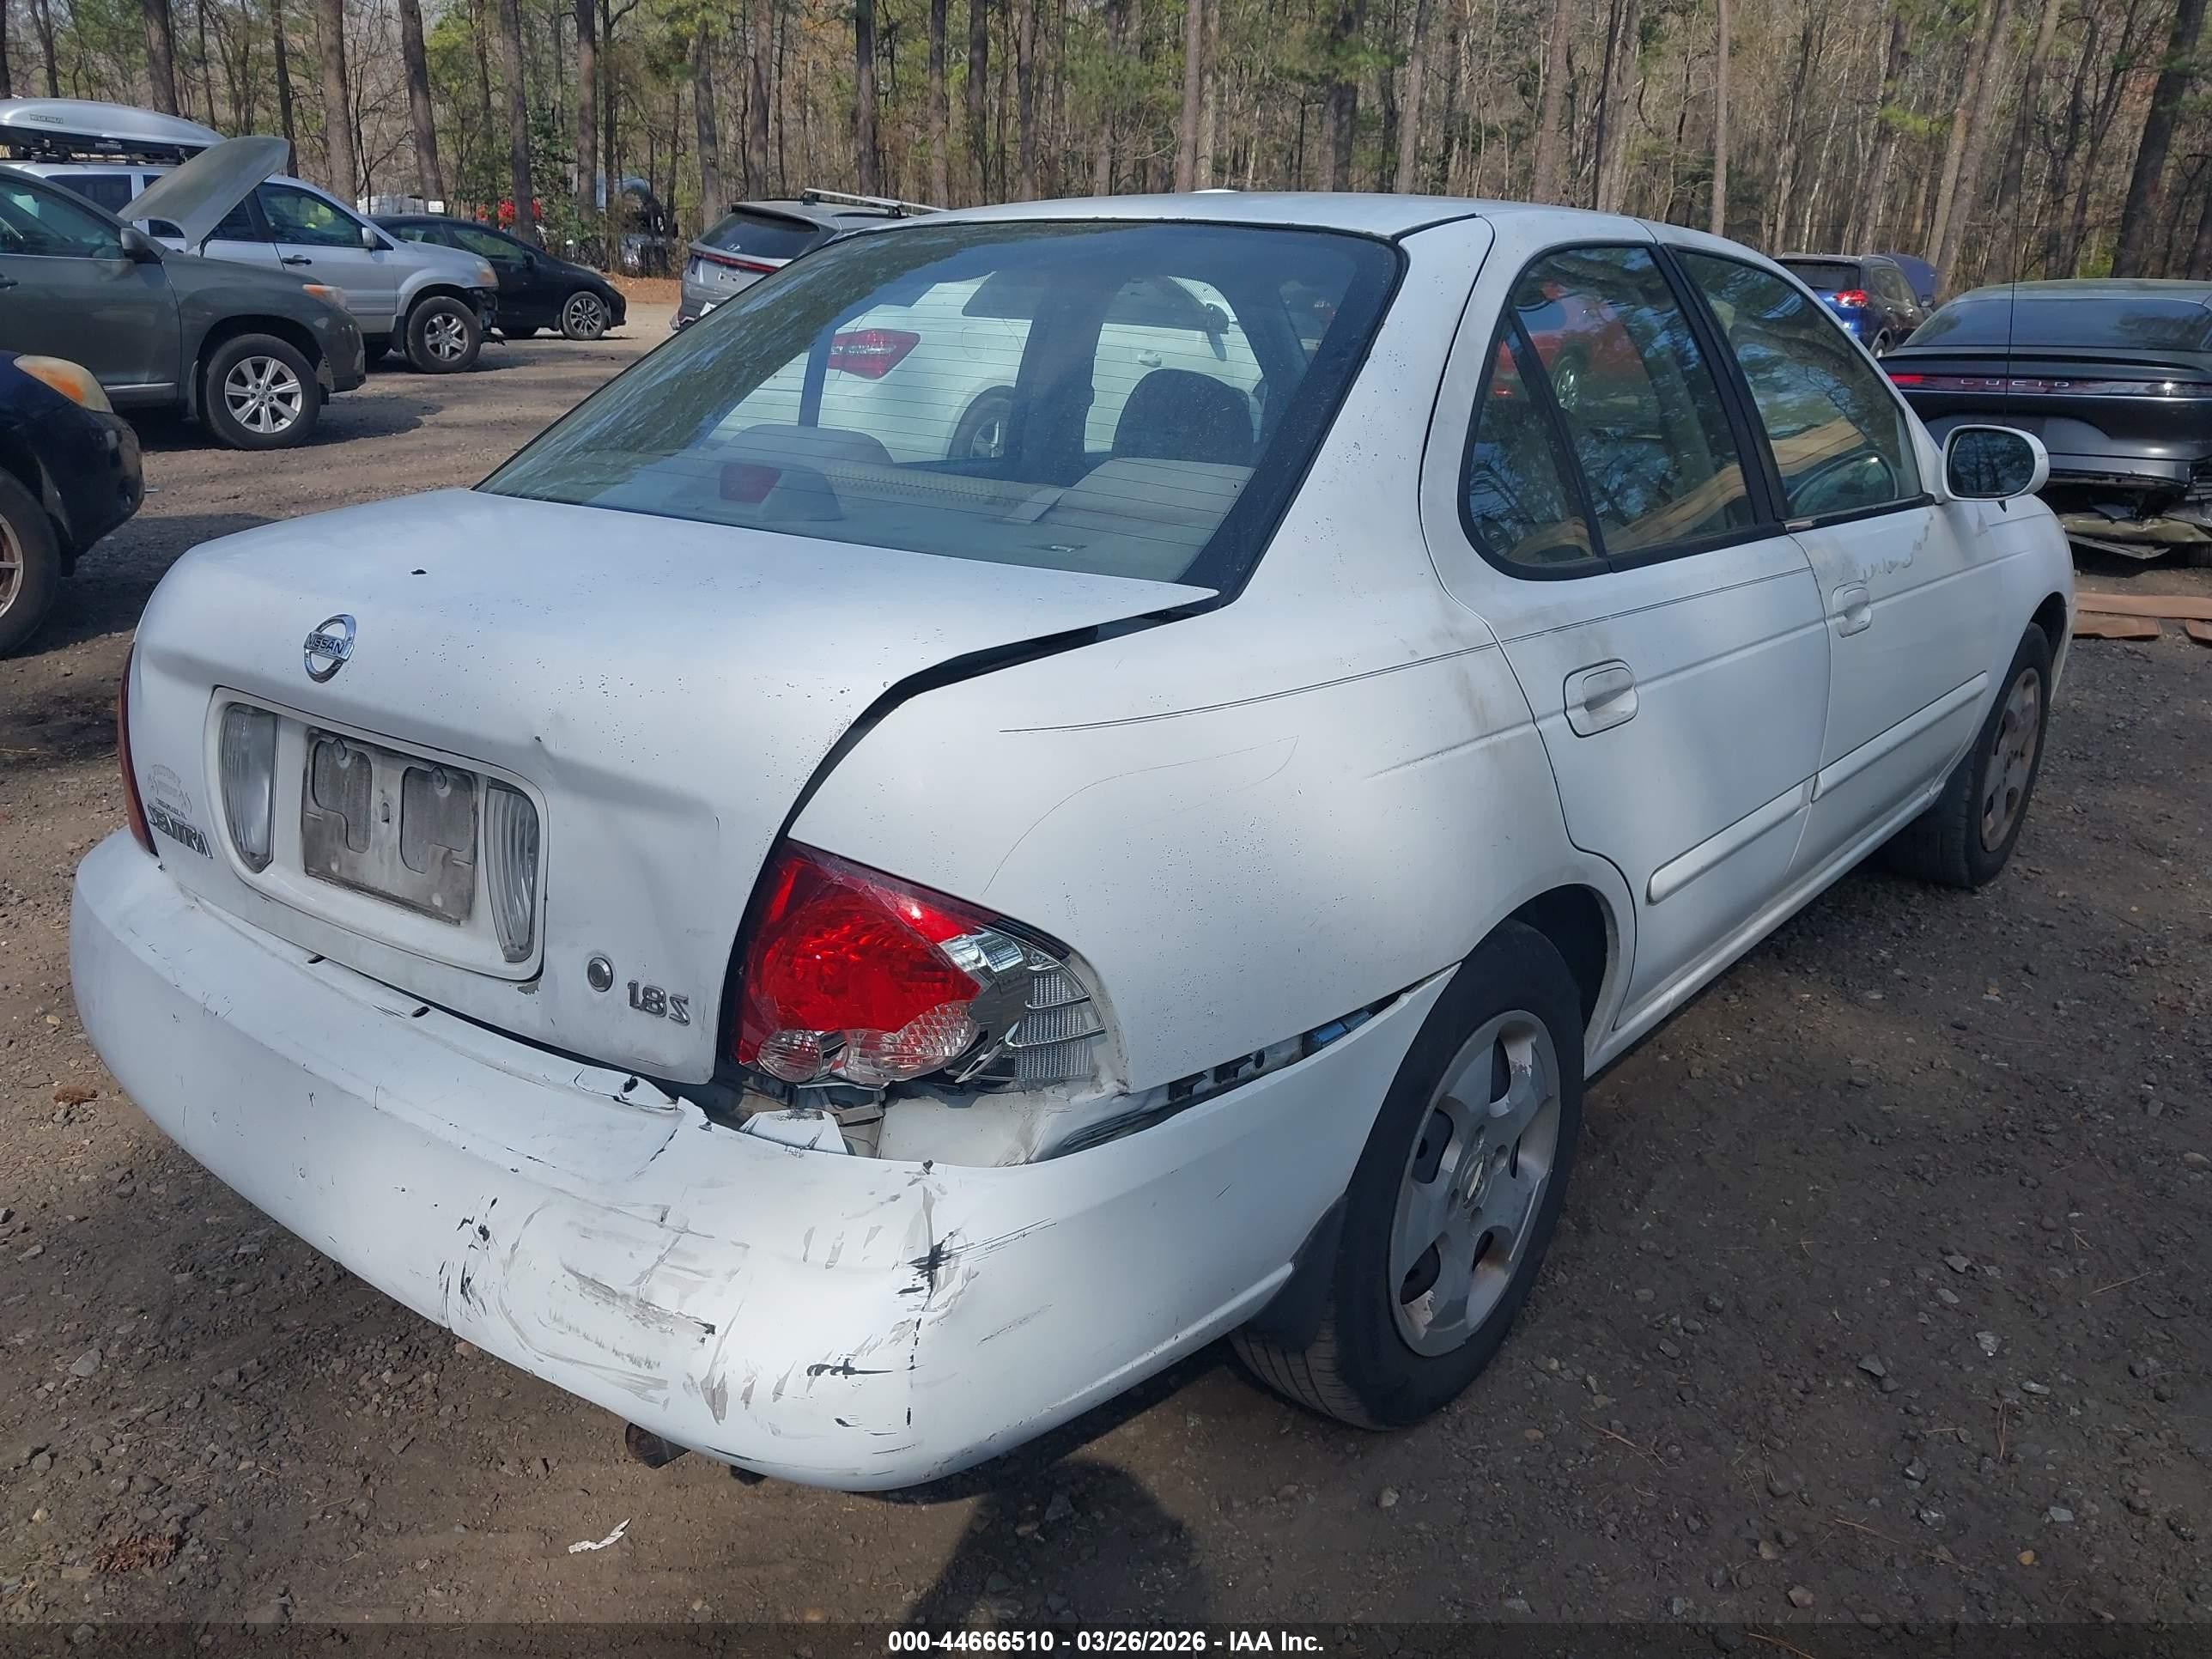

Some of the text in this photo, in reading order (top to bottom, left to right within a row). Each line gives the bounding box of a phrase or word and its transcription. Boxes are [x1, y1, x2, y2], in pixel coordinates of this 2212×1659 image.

[1960, 378, 2070, 388] LUCID
[307, 634, 345, 654] NISSAN
[147, 803, 214, 860] SENTRA
